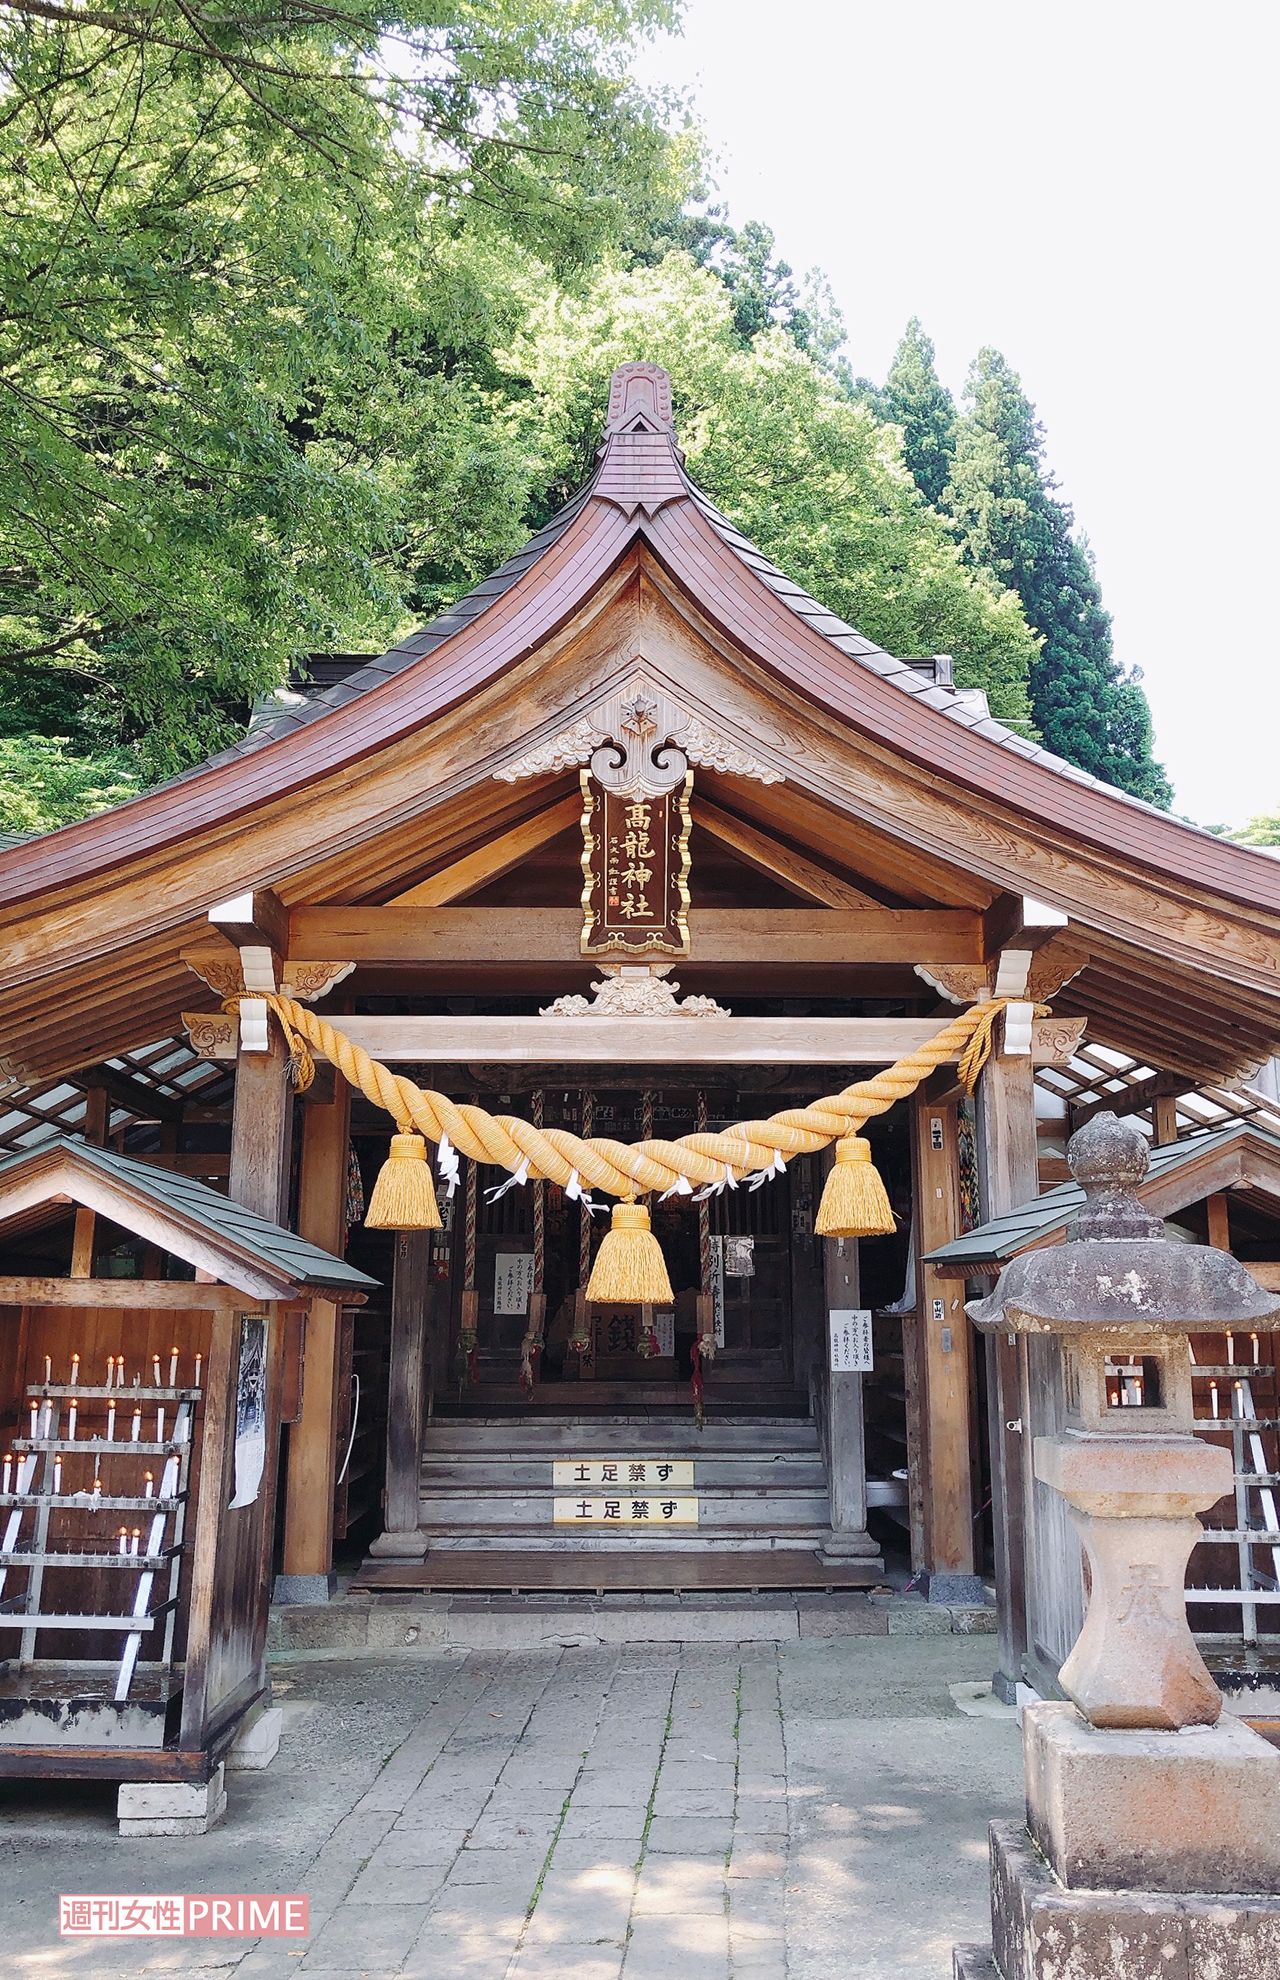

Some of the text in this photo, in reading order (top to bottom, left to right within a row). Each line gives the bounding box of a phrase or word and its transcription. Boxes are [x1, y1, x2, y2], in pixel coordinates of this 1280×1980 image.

[574, 1463, 674, 1482] 土足禁ず
[575, 1500, 678, 1519] 土足禁ず
